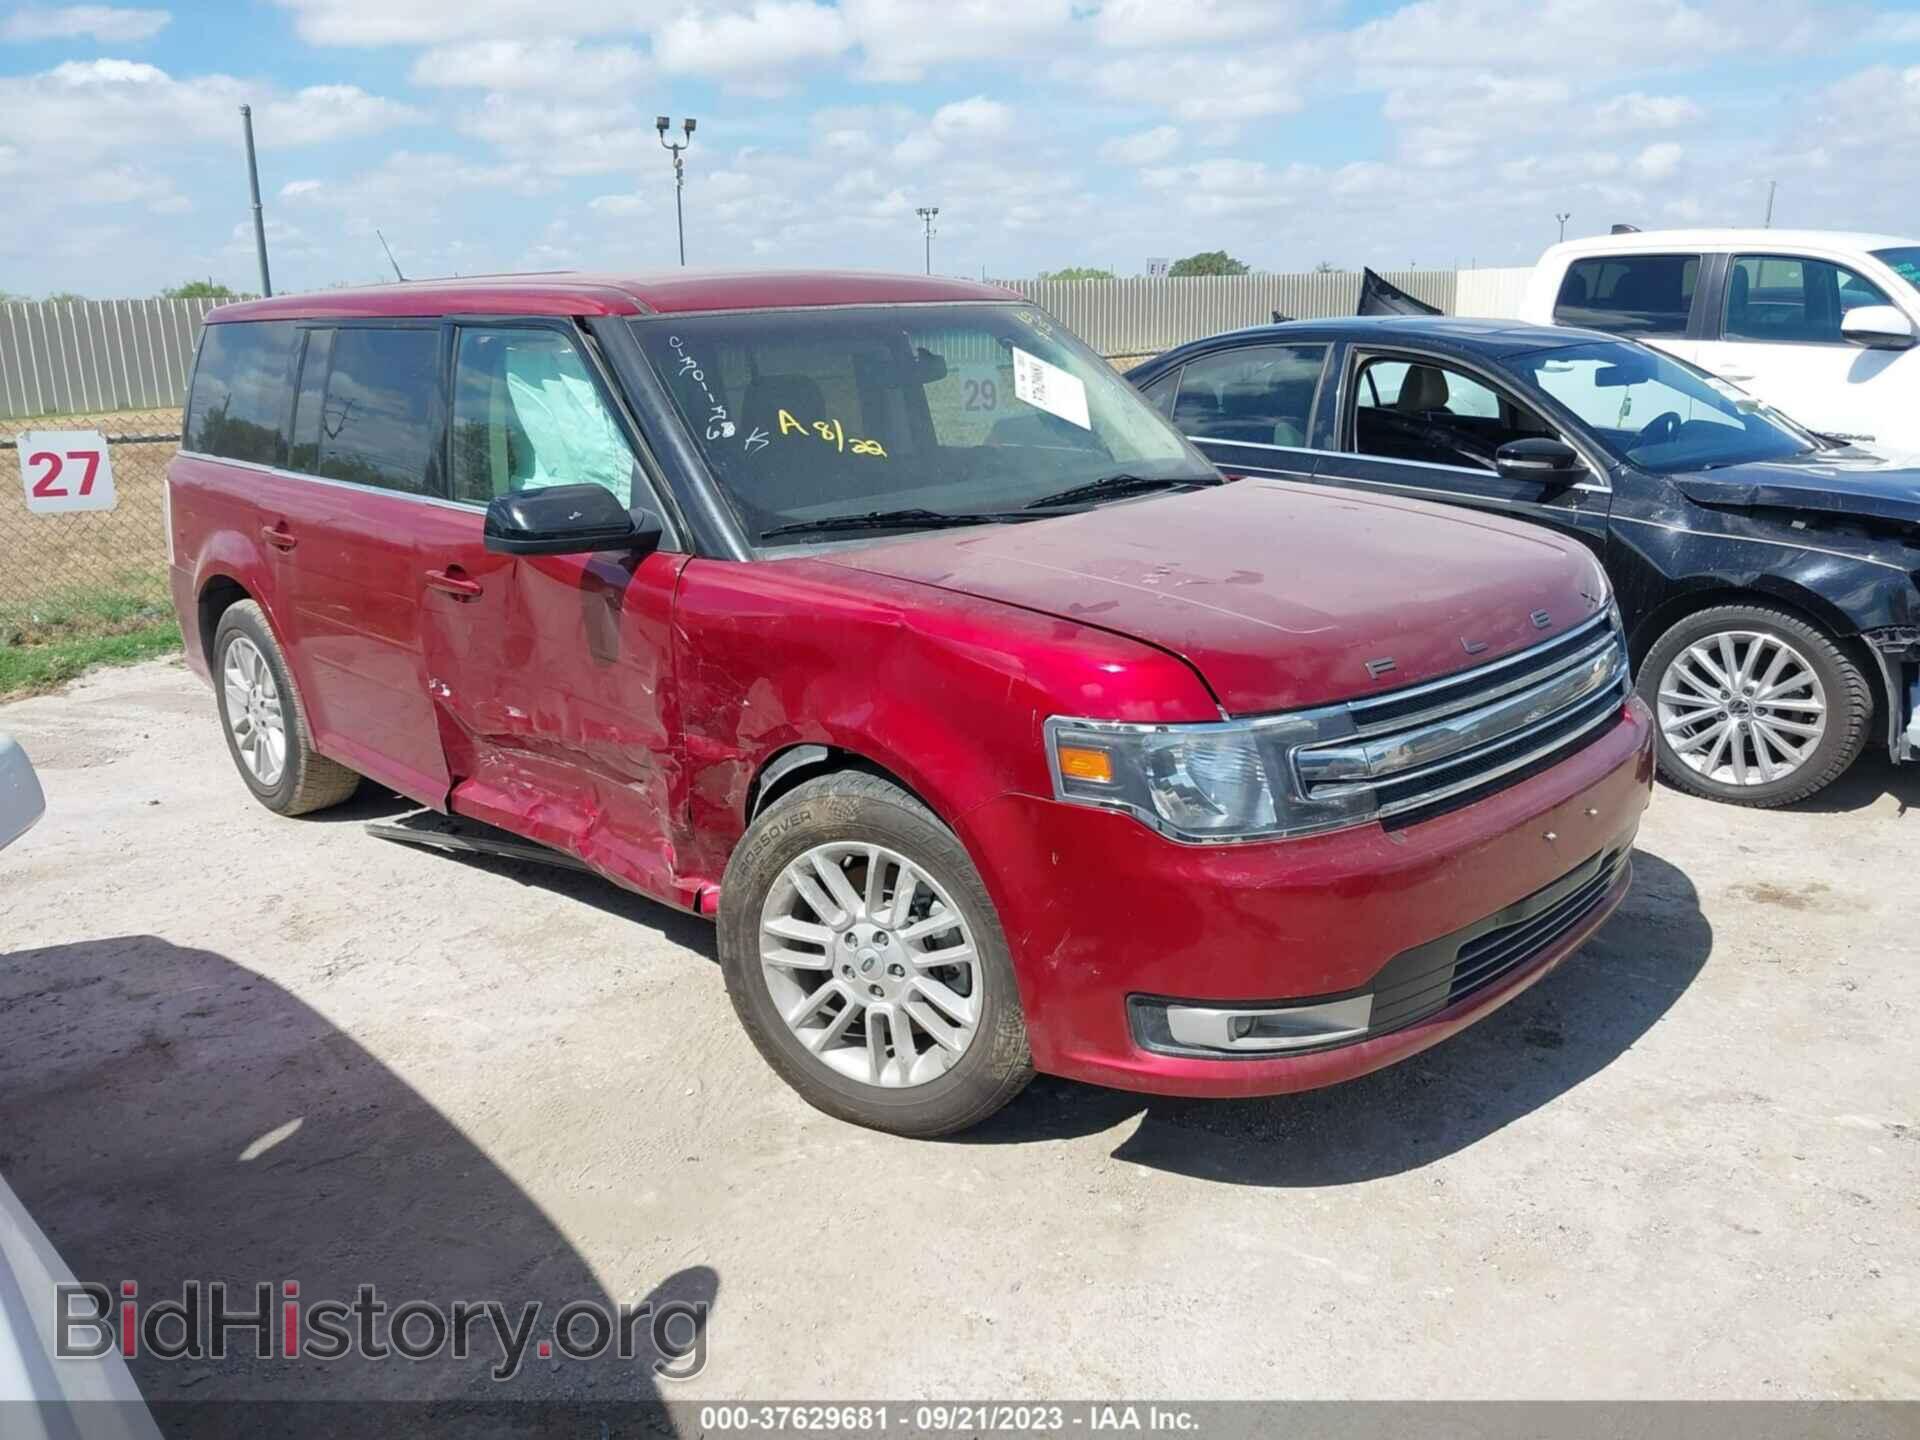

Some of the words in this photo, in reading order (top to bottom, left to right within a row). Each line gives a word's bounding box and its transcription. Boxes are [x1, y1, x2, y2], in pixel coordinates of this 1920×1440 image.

[964, 379, 997, 411] 29
[778, 409, 809, 435] A
[28, 451, 100, 498] 27
